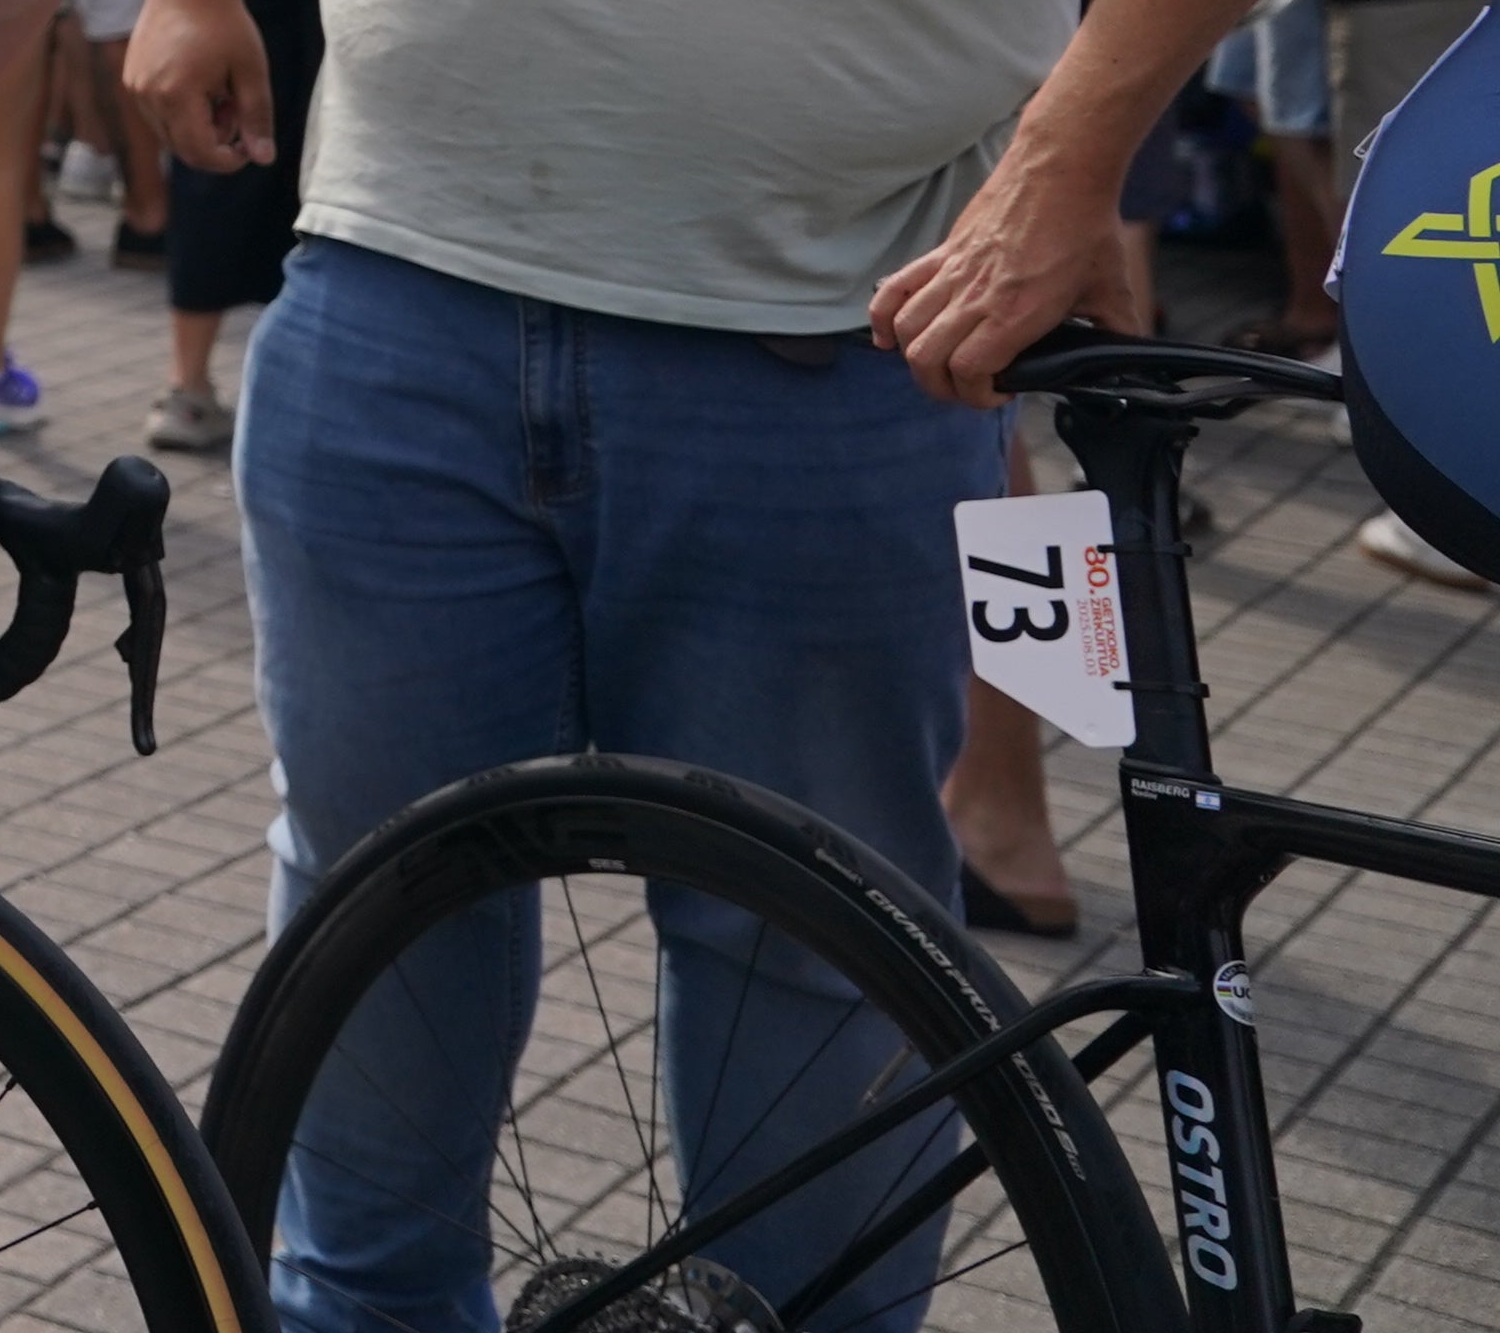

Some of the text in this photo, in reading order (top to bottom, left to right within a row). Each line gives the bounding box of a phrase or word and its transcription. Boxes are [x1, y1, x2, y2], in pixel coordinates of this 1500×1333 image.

[967, 545, 1070, 643] 73
[1084, 546, 1120, 669] 80. GETXOKO
[1091, 598, 1110, 677] ZIRKUITUA
[1131, 777, 1190, 799] RAISBERG
[865, 888, 953, 971] GRAND
[946, 965, 1002, 1032] PRIX
[1165, 1068, 1238, 1292] OSTRO
